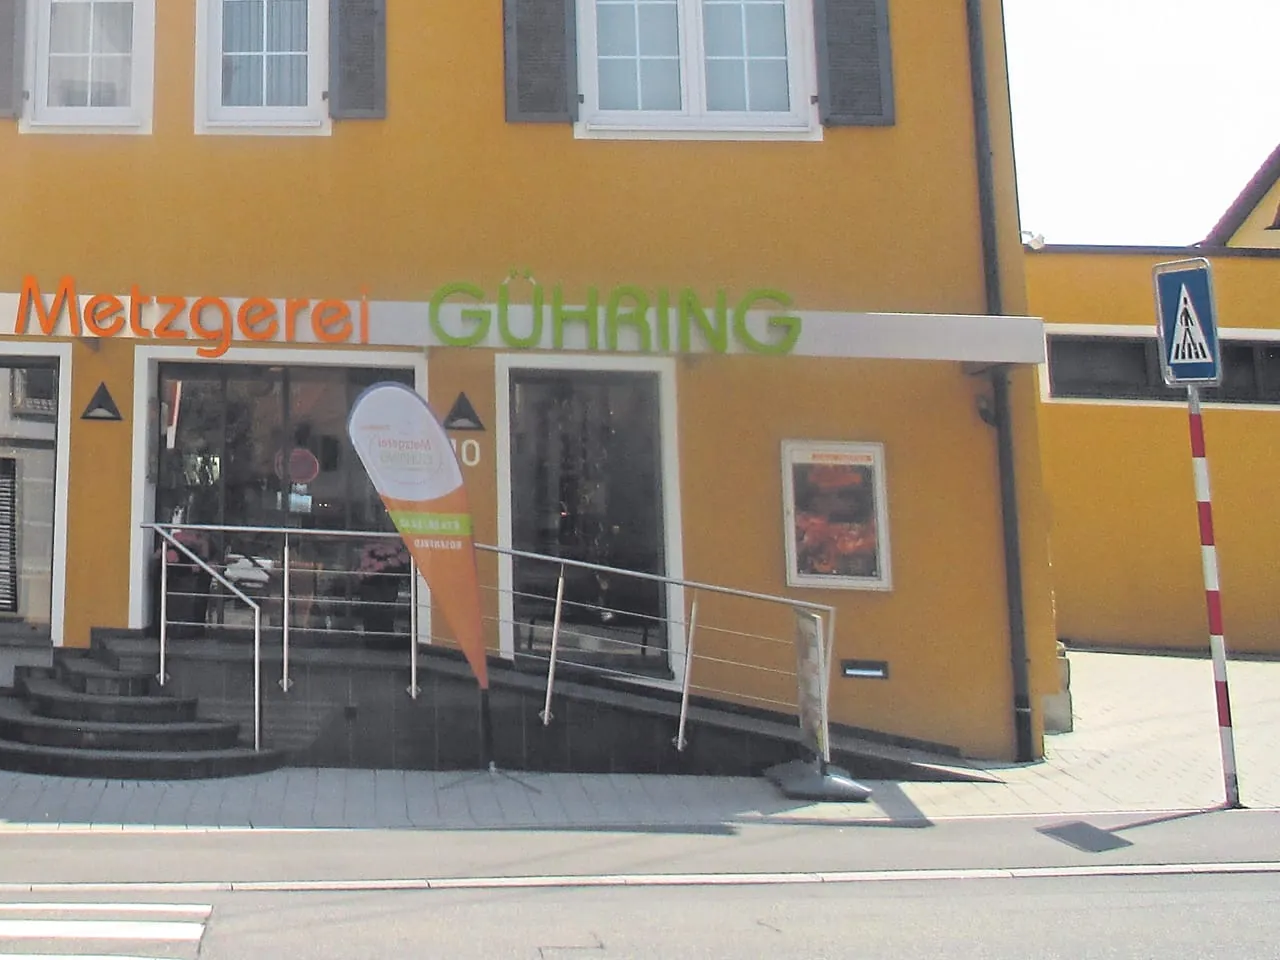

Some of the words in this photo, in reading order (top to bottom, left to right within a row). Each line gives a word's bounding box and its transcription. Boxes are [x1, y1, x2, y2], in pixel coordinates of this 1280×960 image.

[15, 274, 370, 358] Metzgerei
[428, 266, 803, 357] GÜHRING
[450, 439, 481, 467] 0
